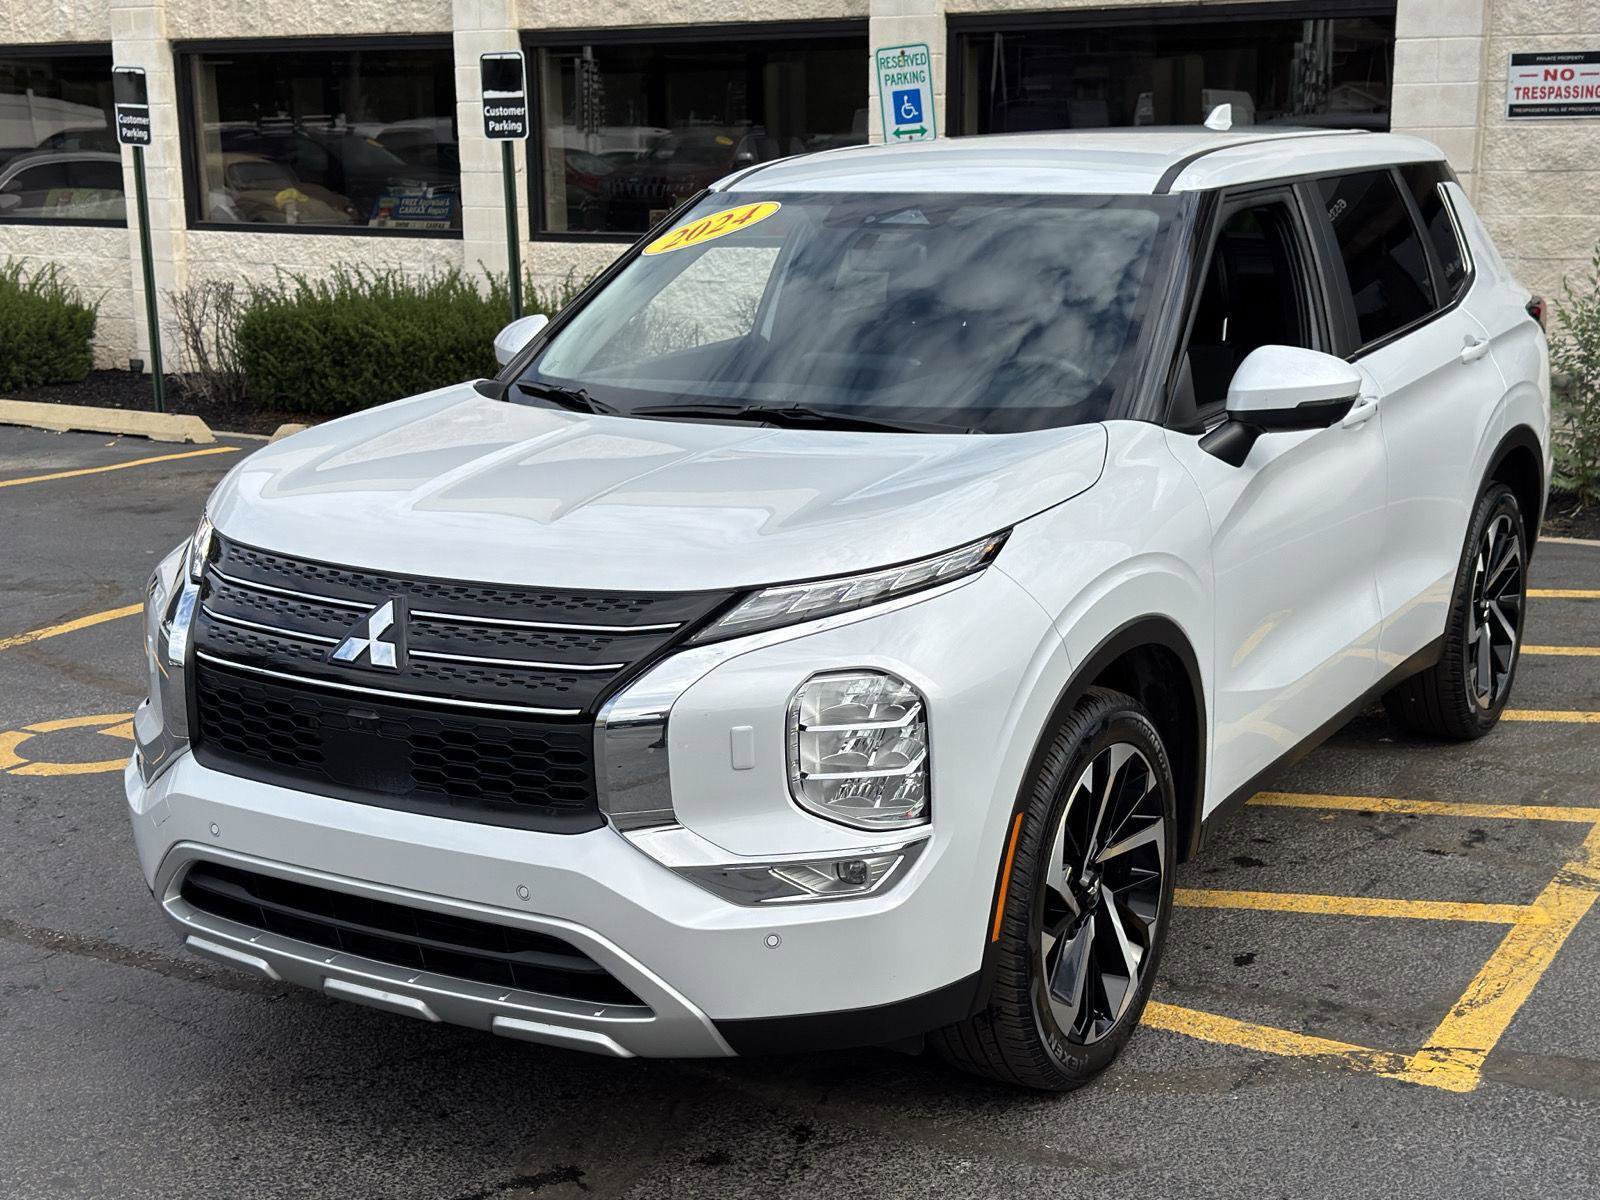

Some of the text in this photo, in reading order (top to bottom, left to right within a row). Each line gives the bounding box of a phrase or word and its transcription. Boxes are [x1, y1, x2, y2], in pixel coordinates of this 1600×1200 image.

[880, 53, 927, 70] RESERVED
[884, 70, 926, 86] PARKING
[1544, 68, 1575, 81] NO
[484, 106, 525, 117] Customer
[119, 113, 150, 125] Customer
[489, 120, 522, 133] Parking
[122, 127, 148, 140] Parking
[662, 205, 761, 250] 2024
